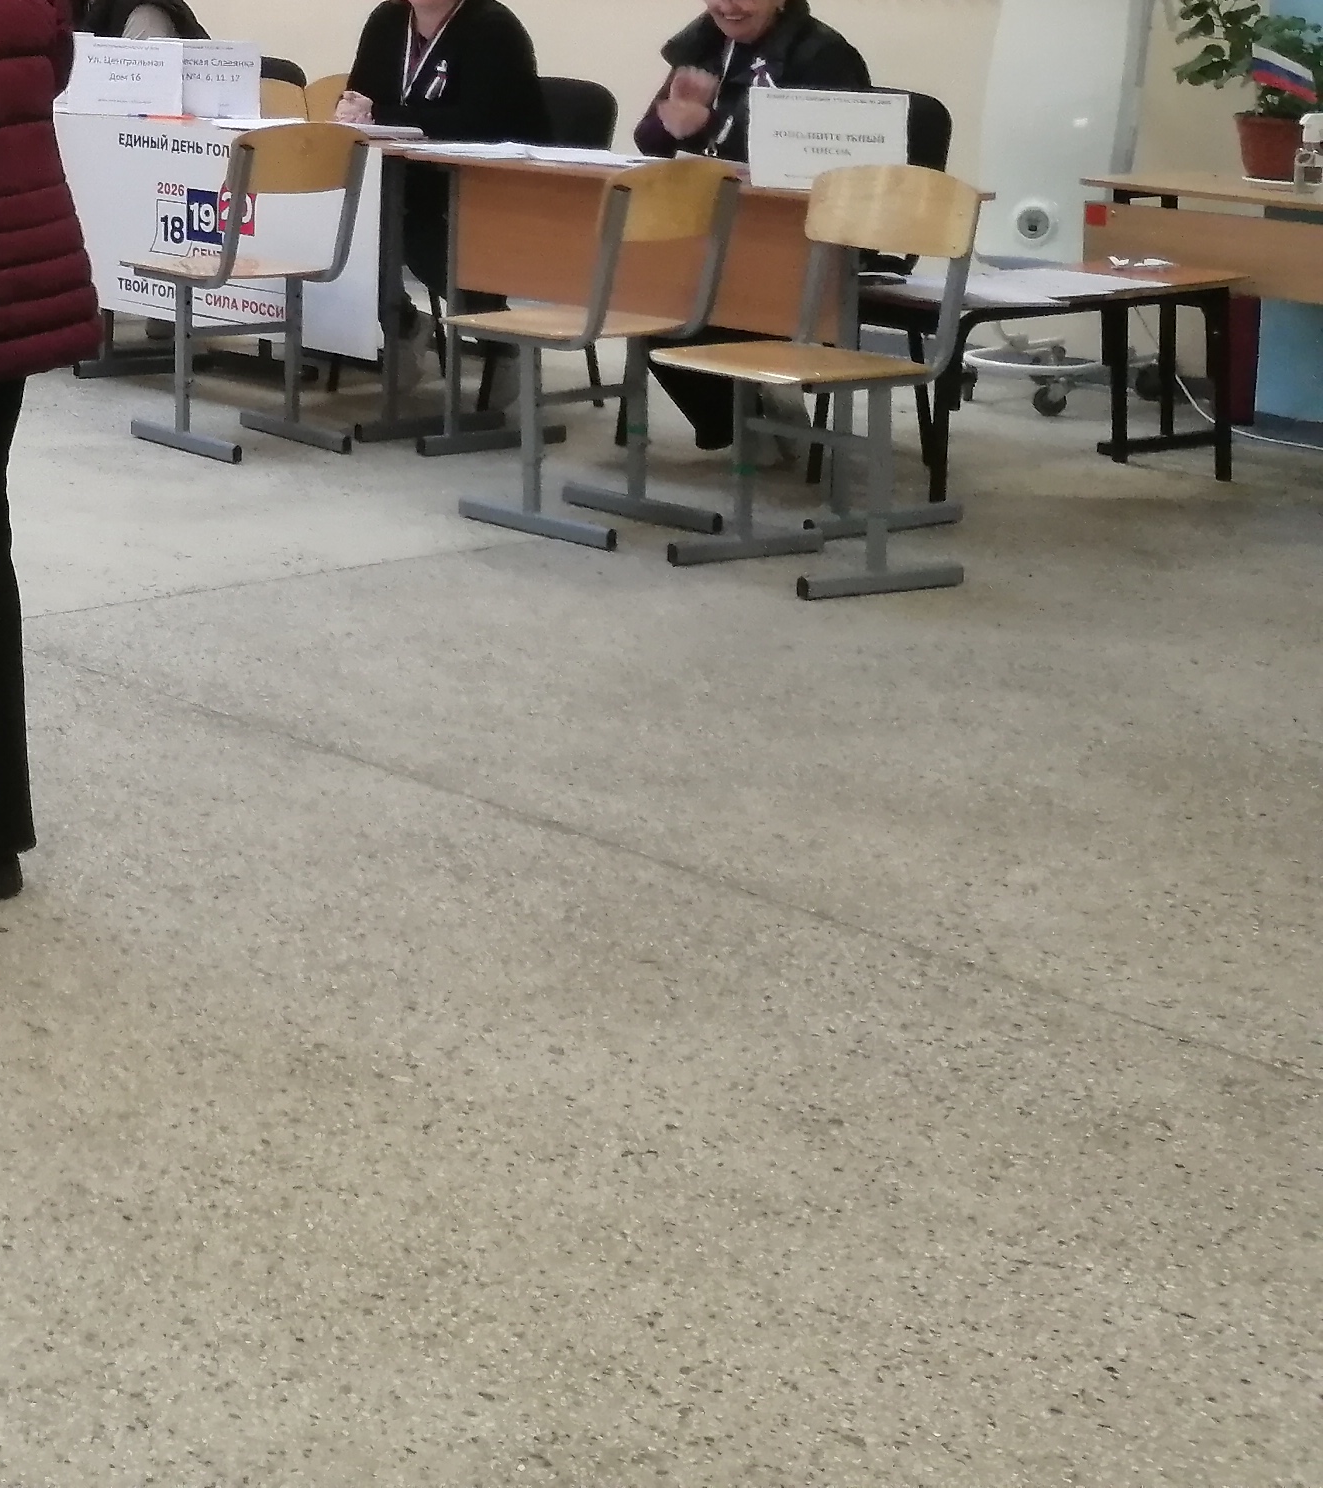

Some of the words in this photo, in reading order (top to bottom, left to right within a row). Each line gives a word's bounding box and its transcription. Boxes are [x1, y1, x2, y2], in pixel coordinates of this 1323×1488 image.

[118, 132, 168, 151] ЕДИНЫЙ
[171, 139, 203, 155] ДЕНЬ
[157, 181, 185, 197] 2026
[160, 214, 185, 244] 18
[189, 202, 216, 233] 19
[117, 276, 149, 294] ТВОЙ
[152, 284, 175, 299] ГОЛ
[205, 293, 238, 310] СИЛА
[242, 299, 285, 319] РОССИ
